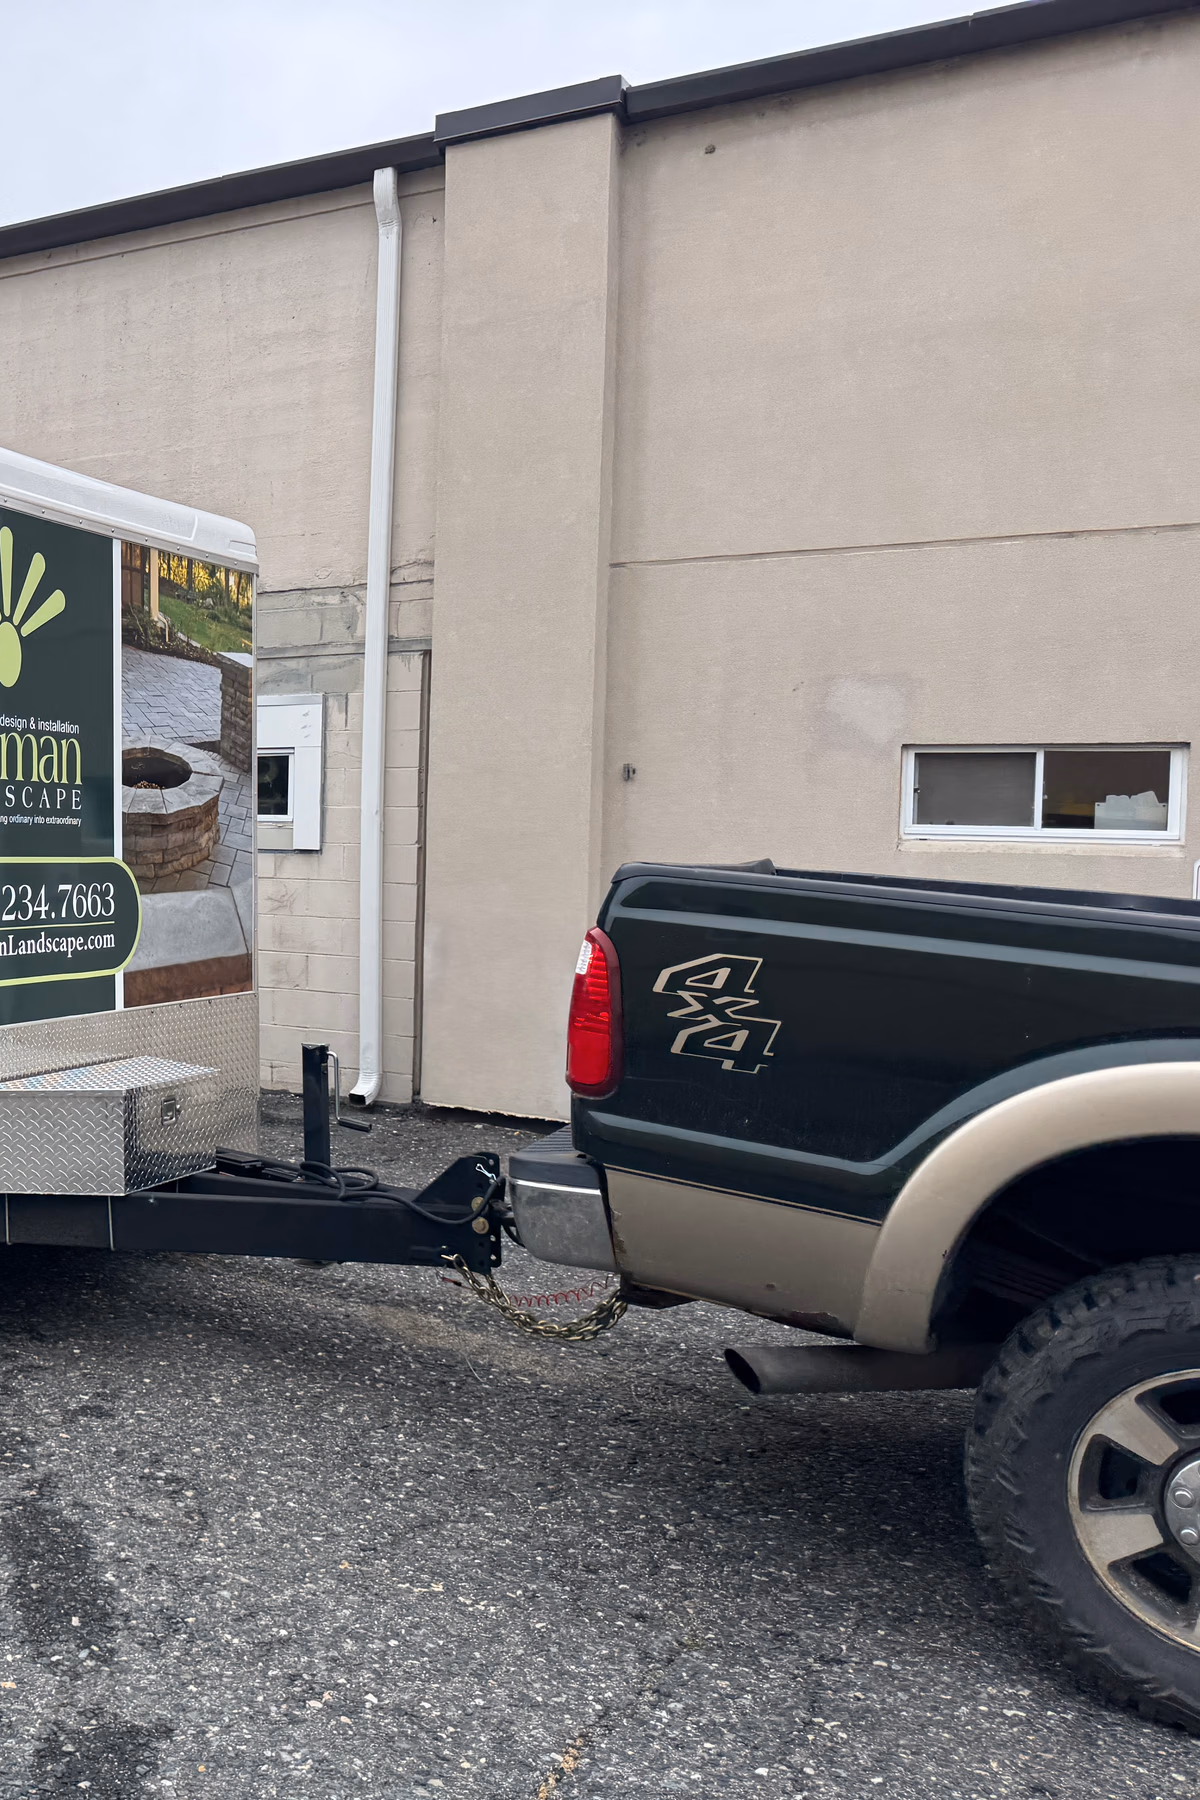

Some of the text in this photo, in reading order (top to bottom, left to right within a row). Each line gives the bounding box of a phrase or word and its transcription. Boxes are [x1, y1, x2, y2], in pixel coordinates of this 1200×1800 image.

[0, 713, 80, 735] design & installation
[9, 814, 33, 826] ordinary
[34, 814, 45, 824] into
[46, 815, 82, 828] extraordinary
